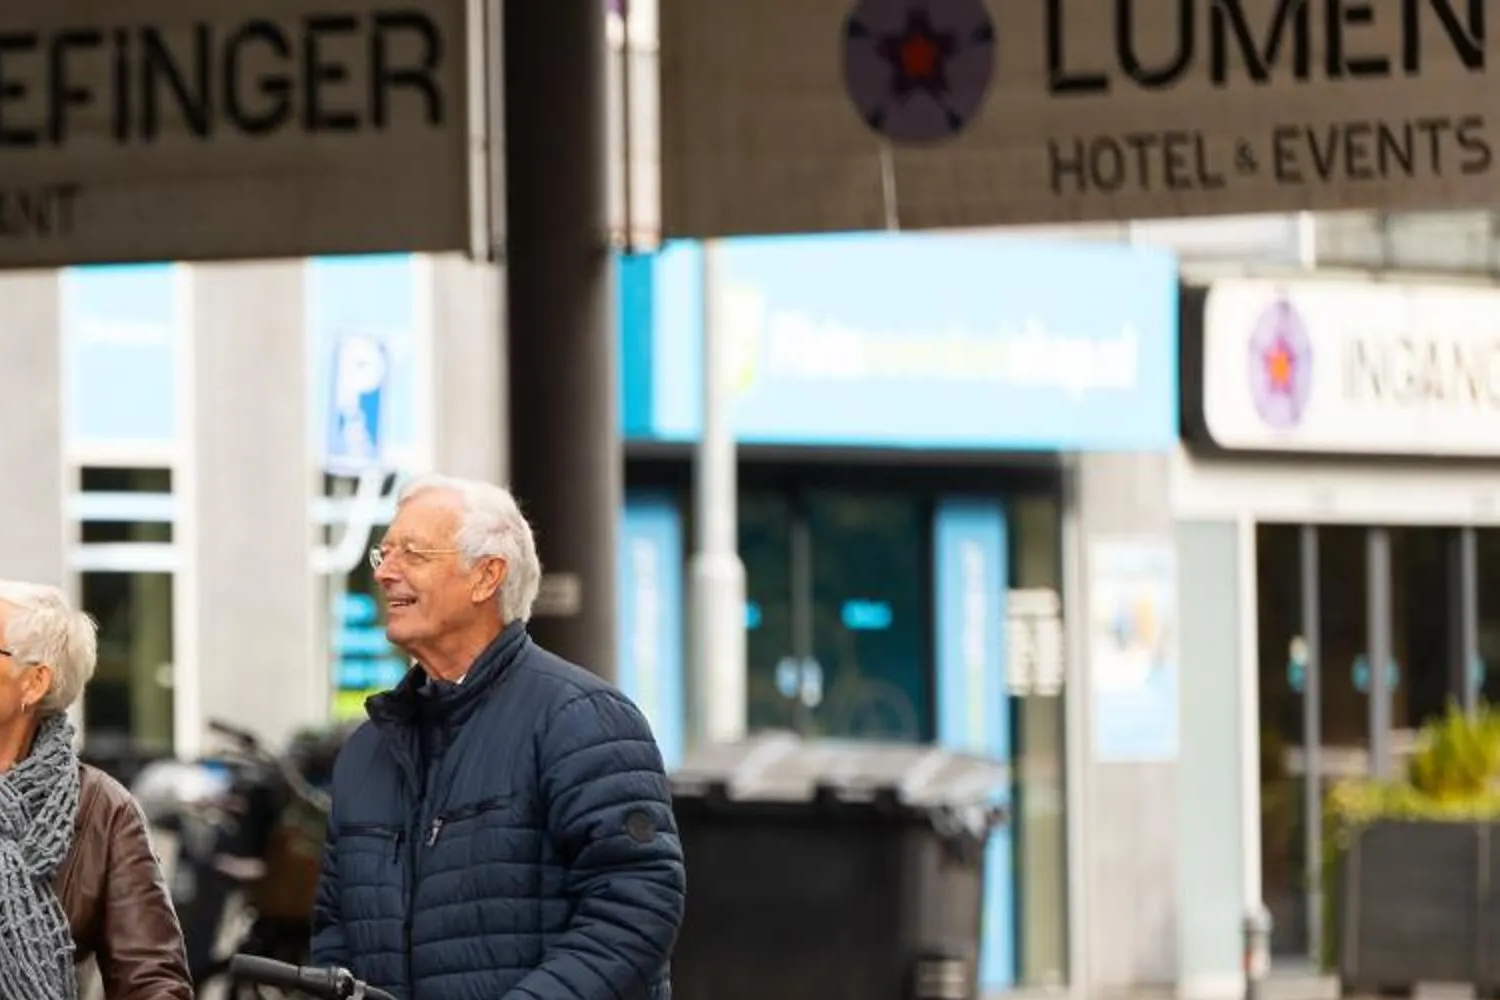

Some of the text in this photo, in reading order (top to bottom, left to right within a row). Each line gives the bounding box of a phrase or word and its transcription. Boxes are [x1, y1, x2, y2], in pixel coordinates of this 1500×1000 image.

[1047, 0, 1486, 93] LUMEN
[1048, 115, 1492, 195] HOTEL & EVENTS
